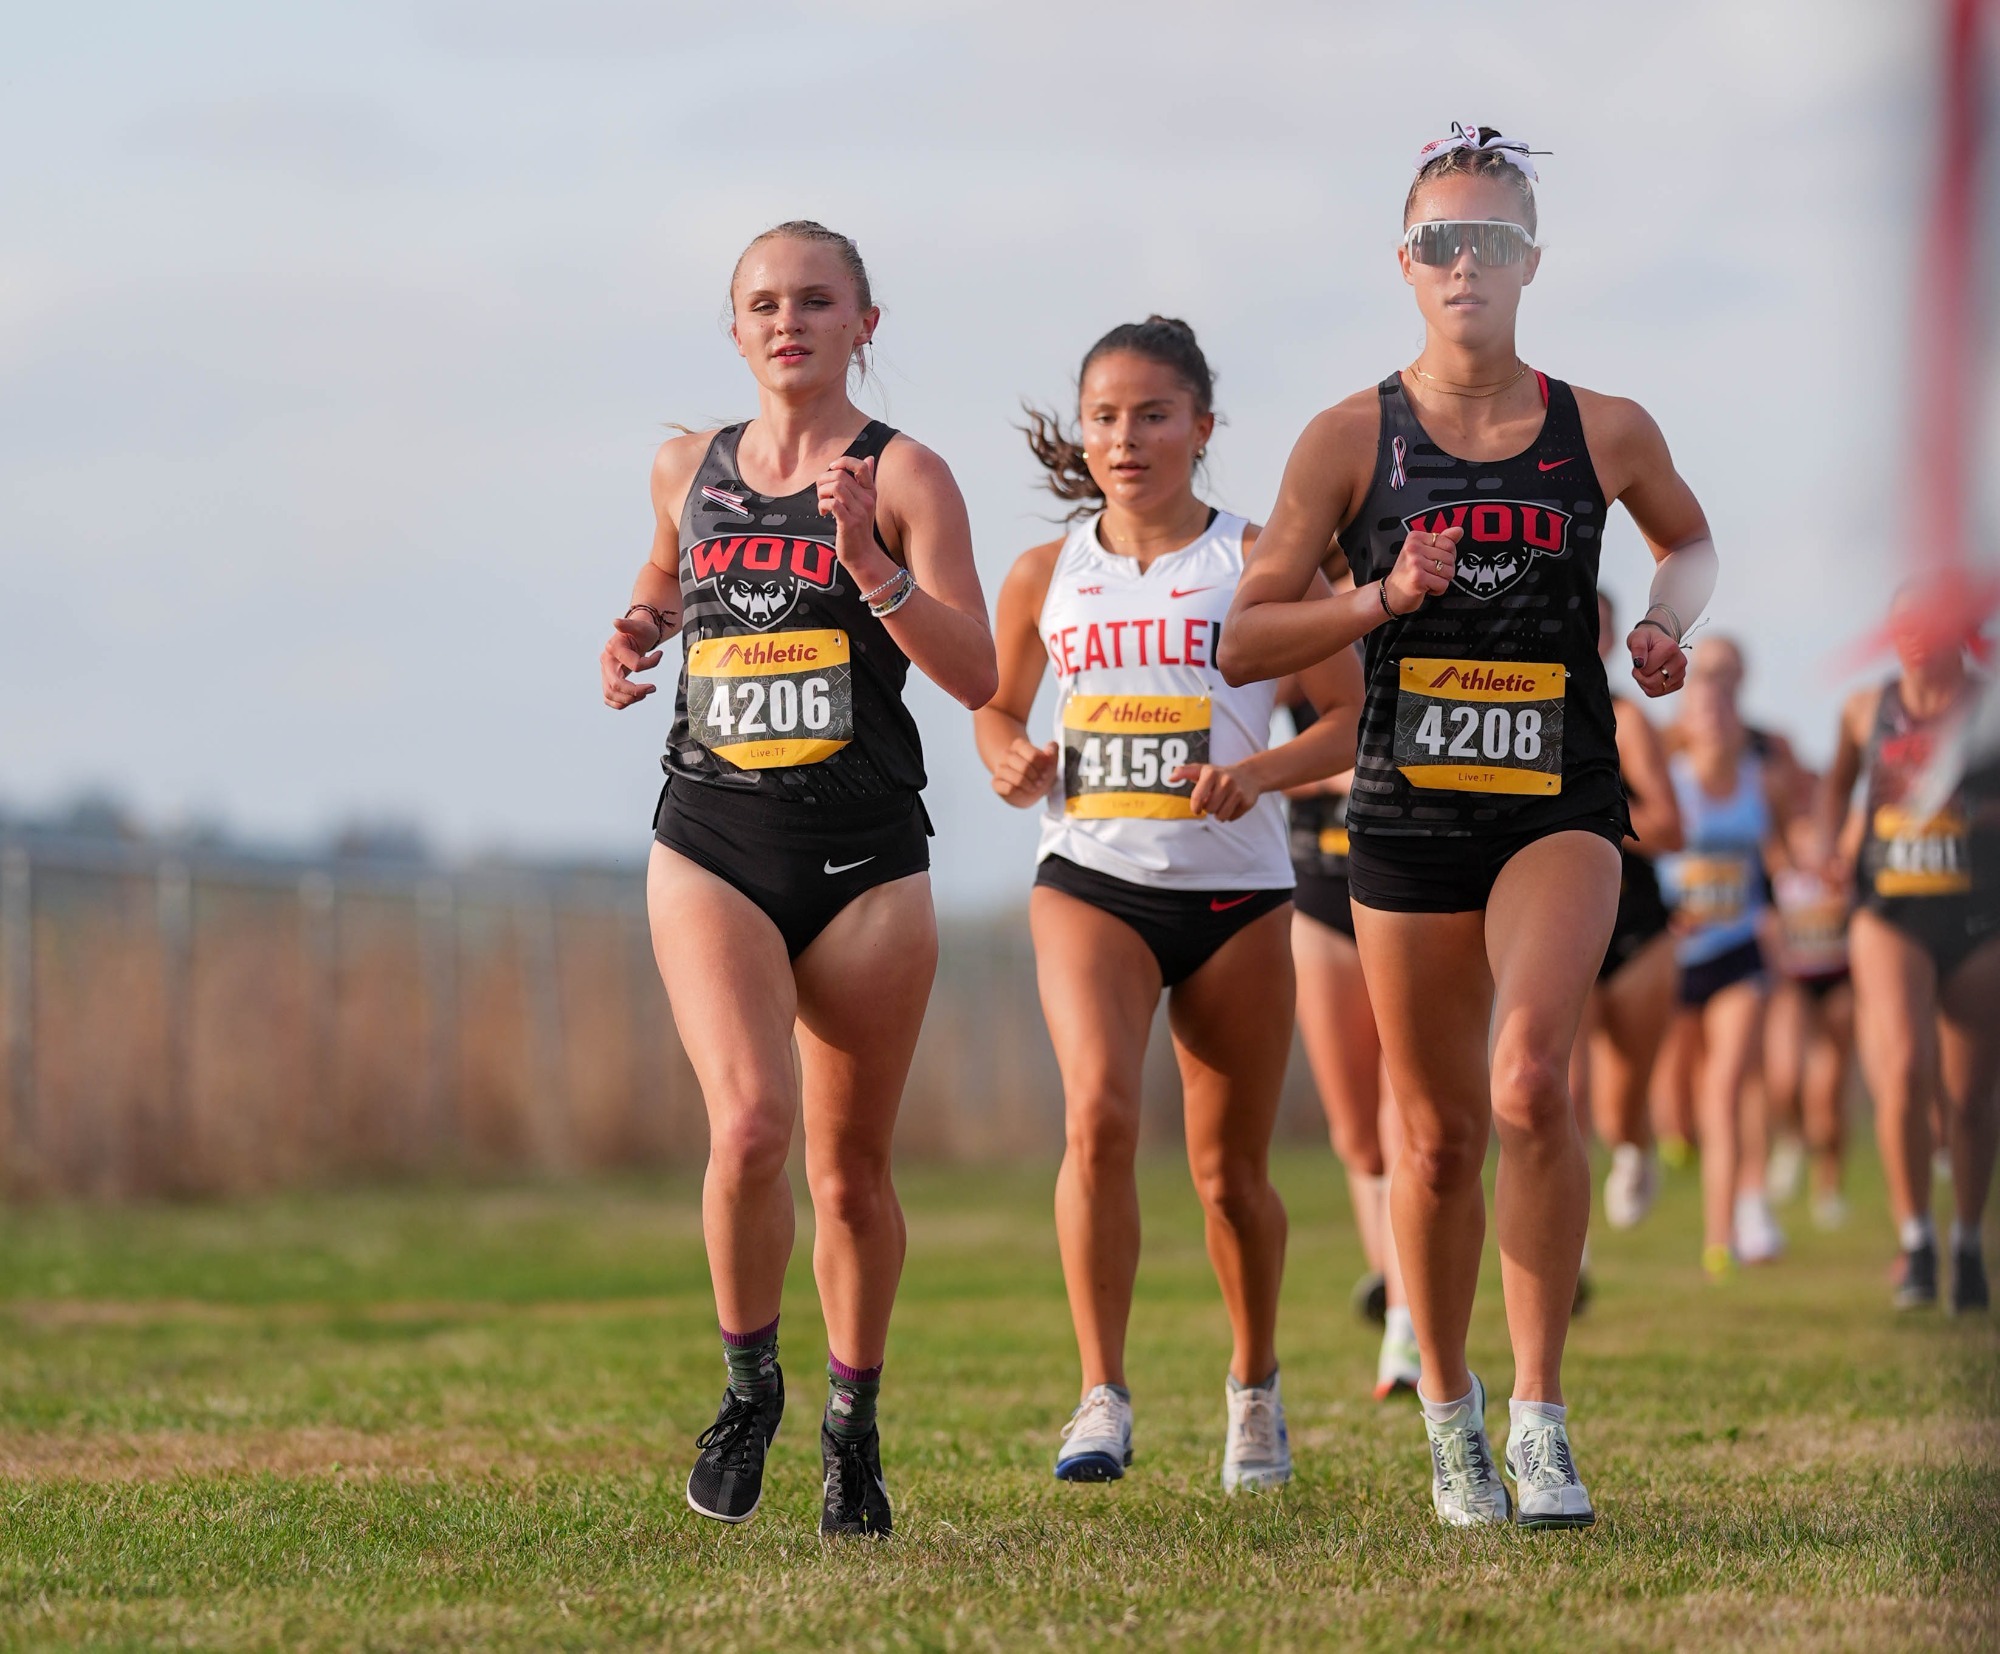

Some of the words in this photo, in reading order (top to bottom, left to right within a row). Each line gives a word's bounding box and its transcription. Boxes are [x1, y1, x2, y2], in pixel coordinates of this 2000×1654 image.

[1410, 505, 1563, 550] WOU
[692, 537, 836, 584] WOU
[716, 641, 819, 669] Athletic
[1429, 665, 1536, 693] Athletic
[707, 677, 831, 736] 4206
[1087, 702, 1182, 723] Athletic
[1415, 705, 1542, 761] 4208
[750, 747, 787, 758] Live.TF
[1078, 737, 1189, 788] 4158
[1458, 772, 1496, 783] Live.TF
